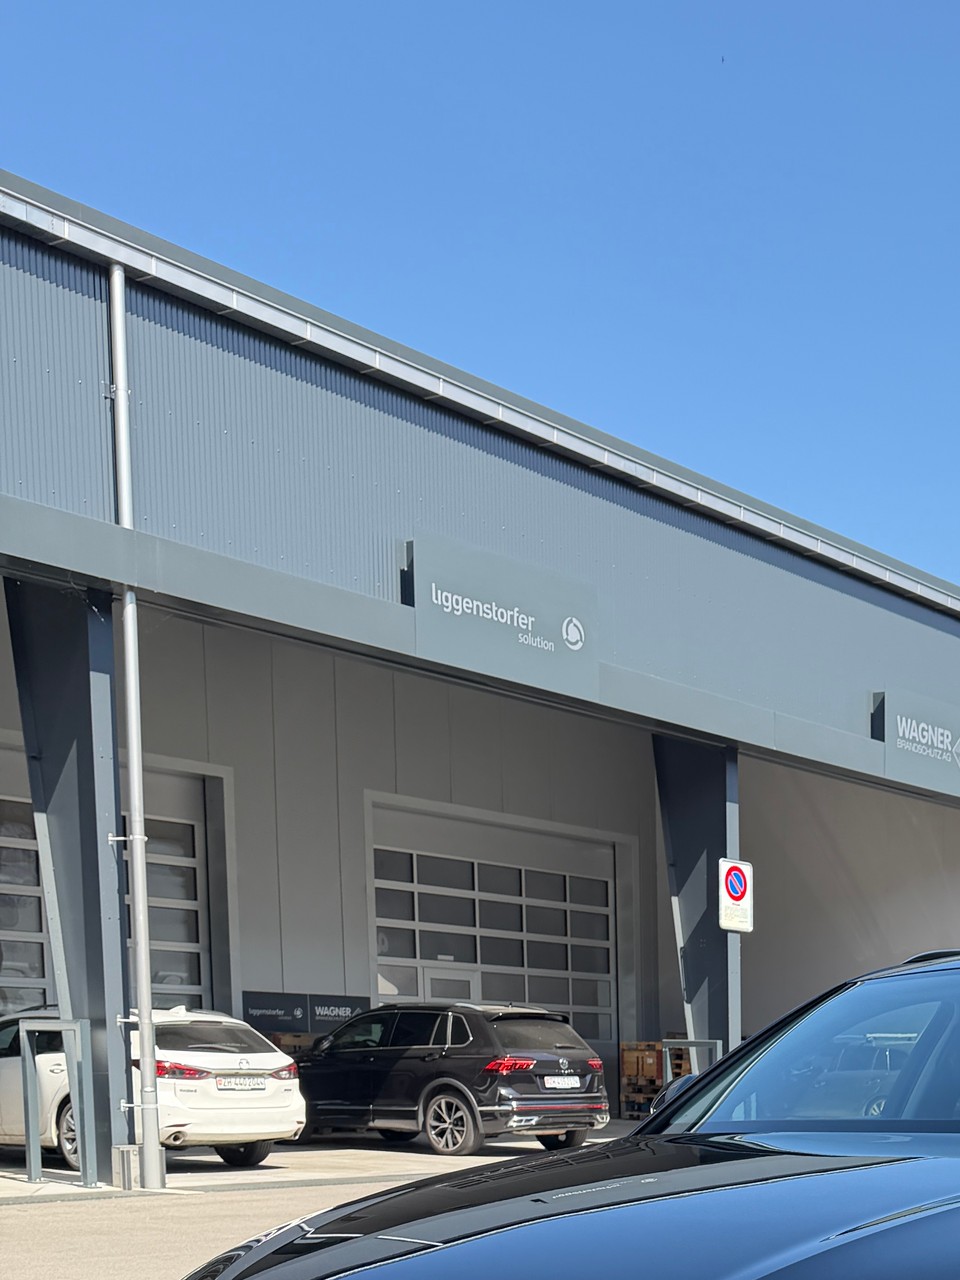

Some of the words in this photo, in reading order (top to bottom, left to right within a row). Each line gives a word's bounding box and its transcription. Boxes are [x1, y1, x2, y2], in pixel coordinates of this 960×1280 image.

[432, 582, 536, 631] liggenstorfer
[518, 632, 555, 652] solution
[896, 714, 952, 752] WAGNER
[896, 738, 942, 760] BRANDSCHUTZ
[315, 1006, 352, 1017] WAGNER
